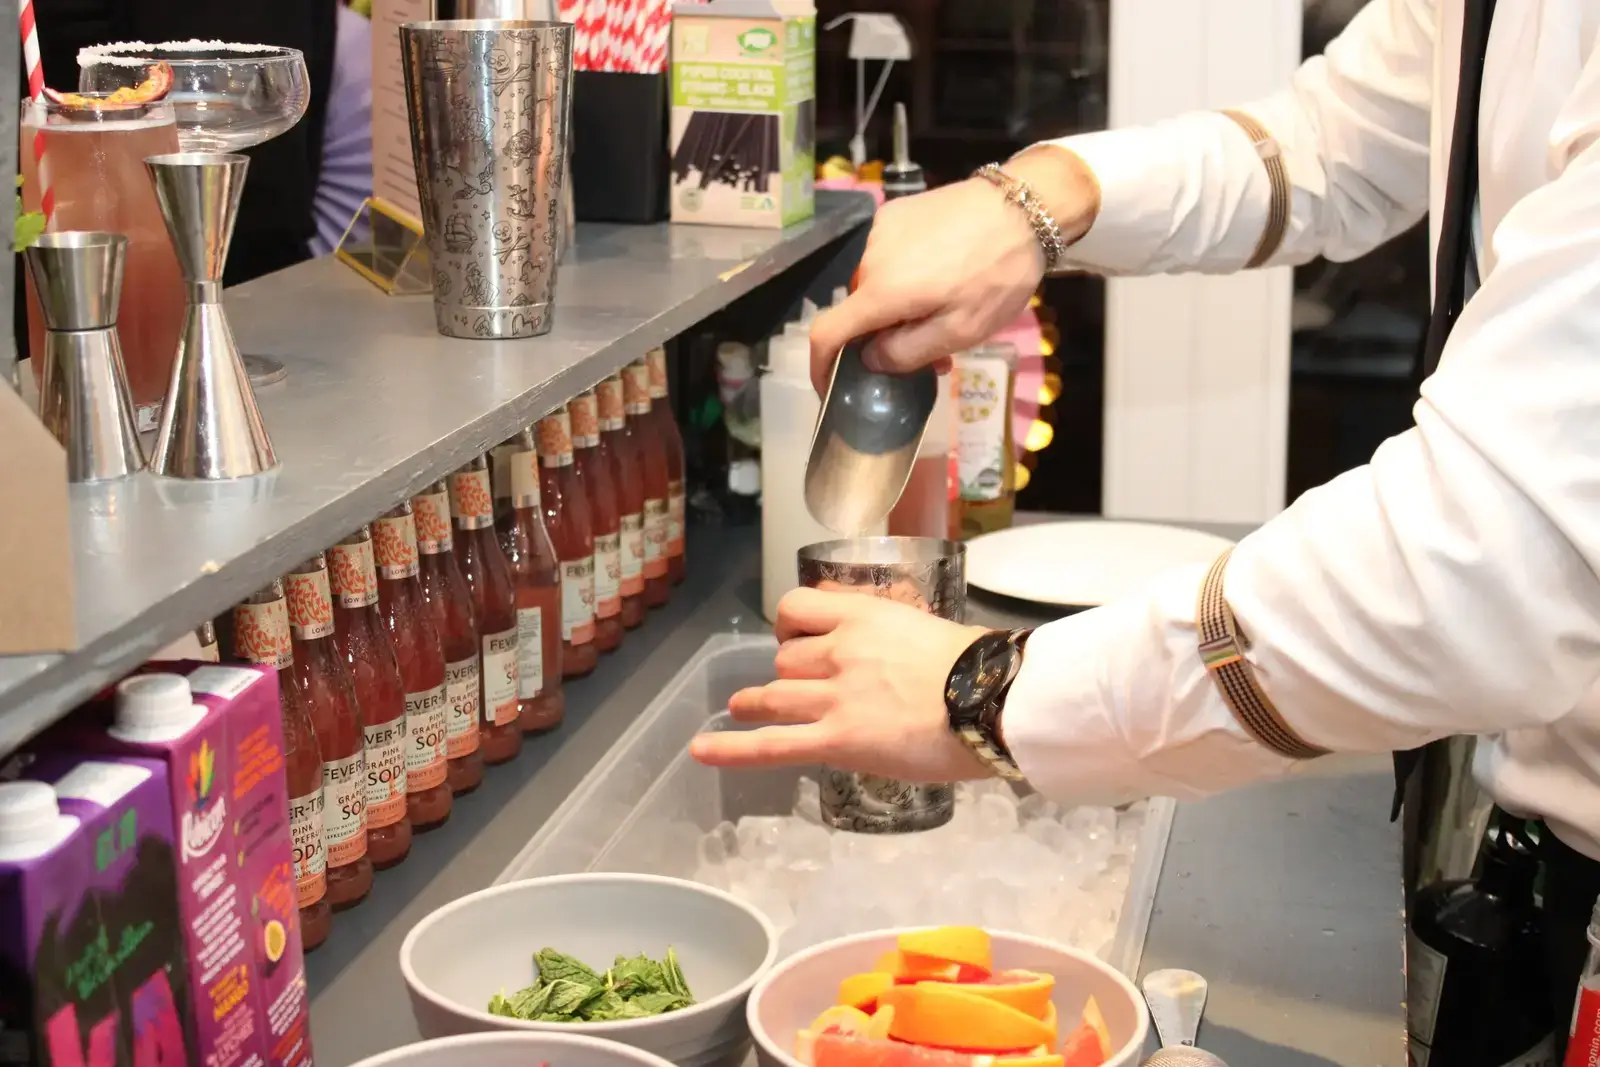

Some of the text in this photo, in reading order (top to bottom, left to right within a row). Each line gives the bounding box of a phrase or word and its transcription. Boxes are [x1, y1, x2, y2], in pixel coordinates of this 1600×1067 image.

[382, 747, 400, 757] PINK
[293, 822, 313, 836] PINK
[1587, 1008, 1600, 1067] onin.com
